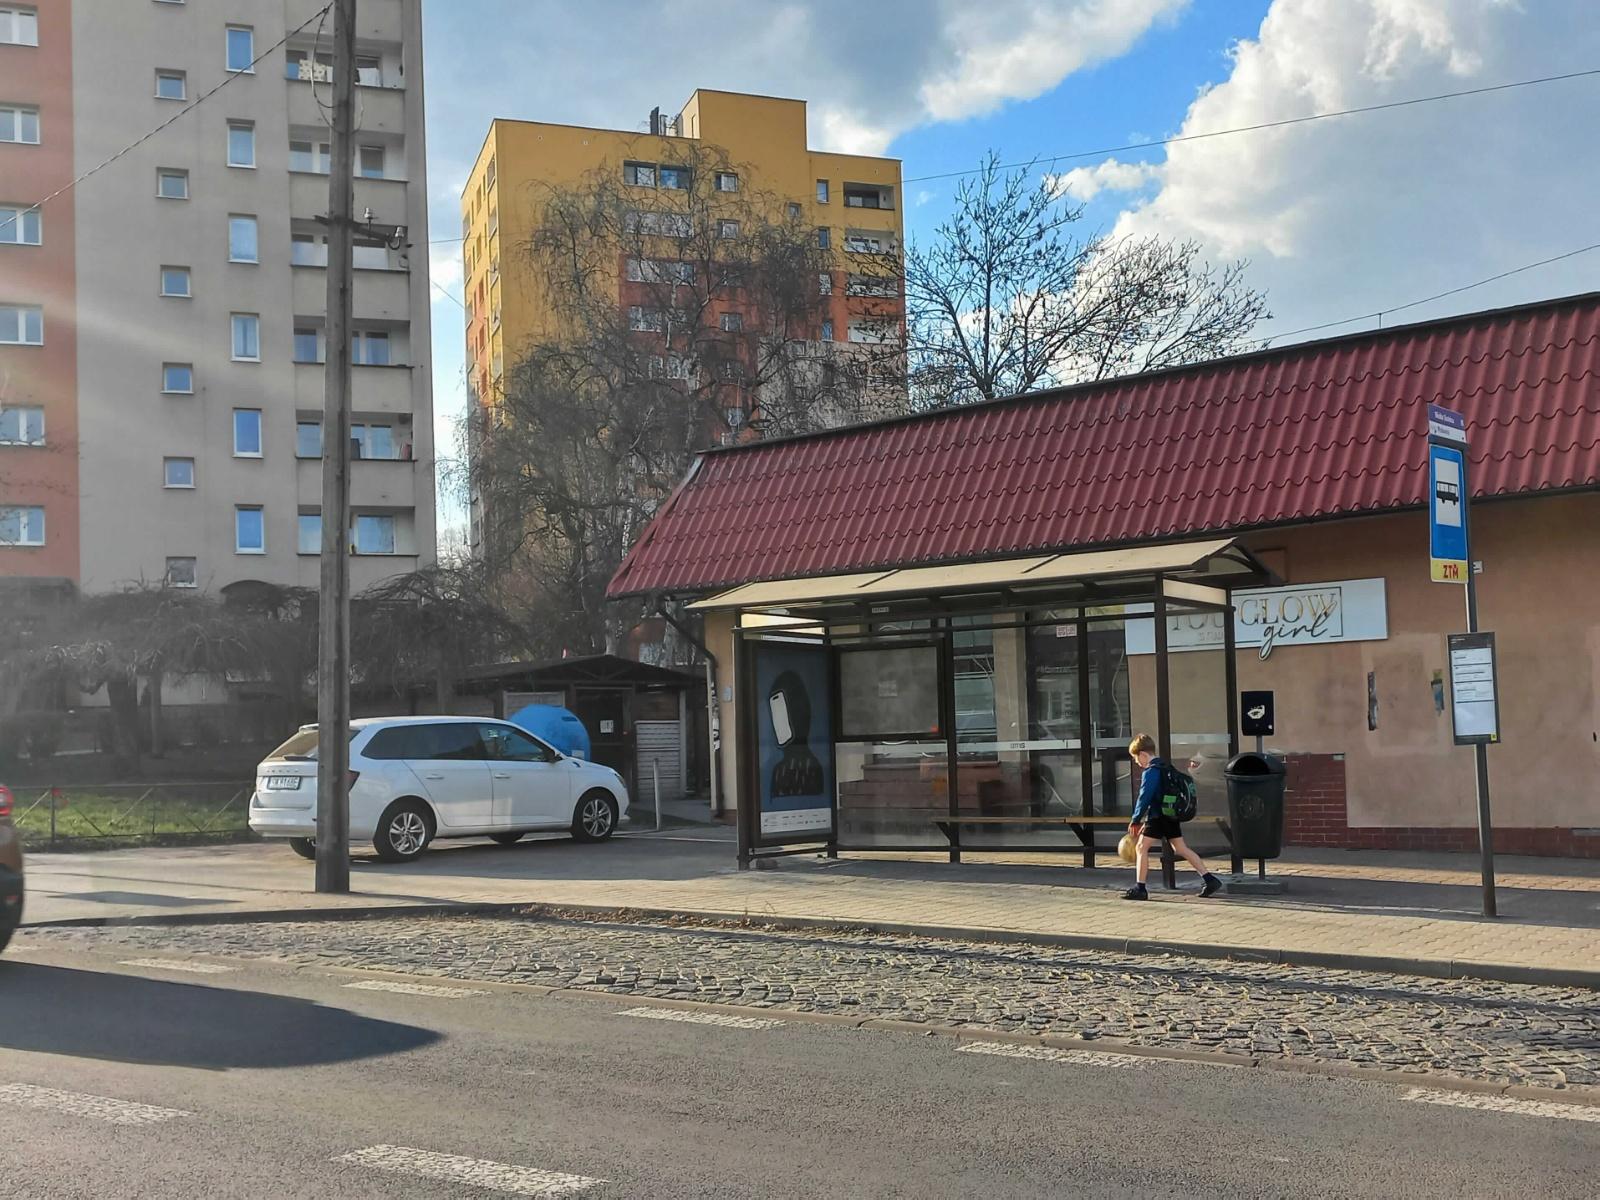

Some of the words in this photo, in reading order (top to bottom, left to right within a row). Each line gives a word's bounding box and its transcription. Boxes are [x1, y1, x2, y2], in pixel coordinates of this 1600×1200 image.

[1443, 564, 1459, 579] ZTM
[1239, 593, 1337, 626] GLOW
[1259, 601, 1338, 661] girl
